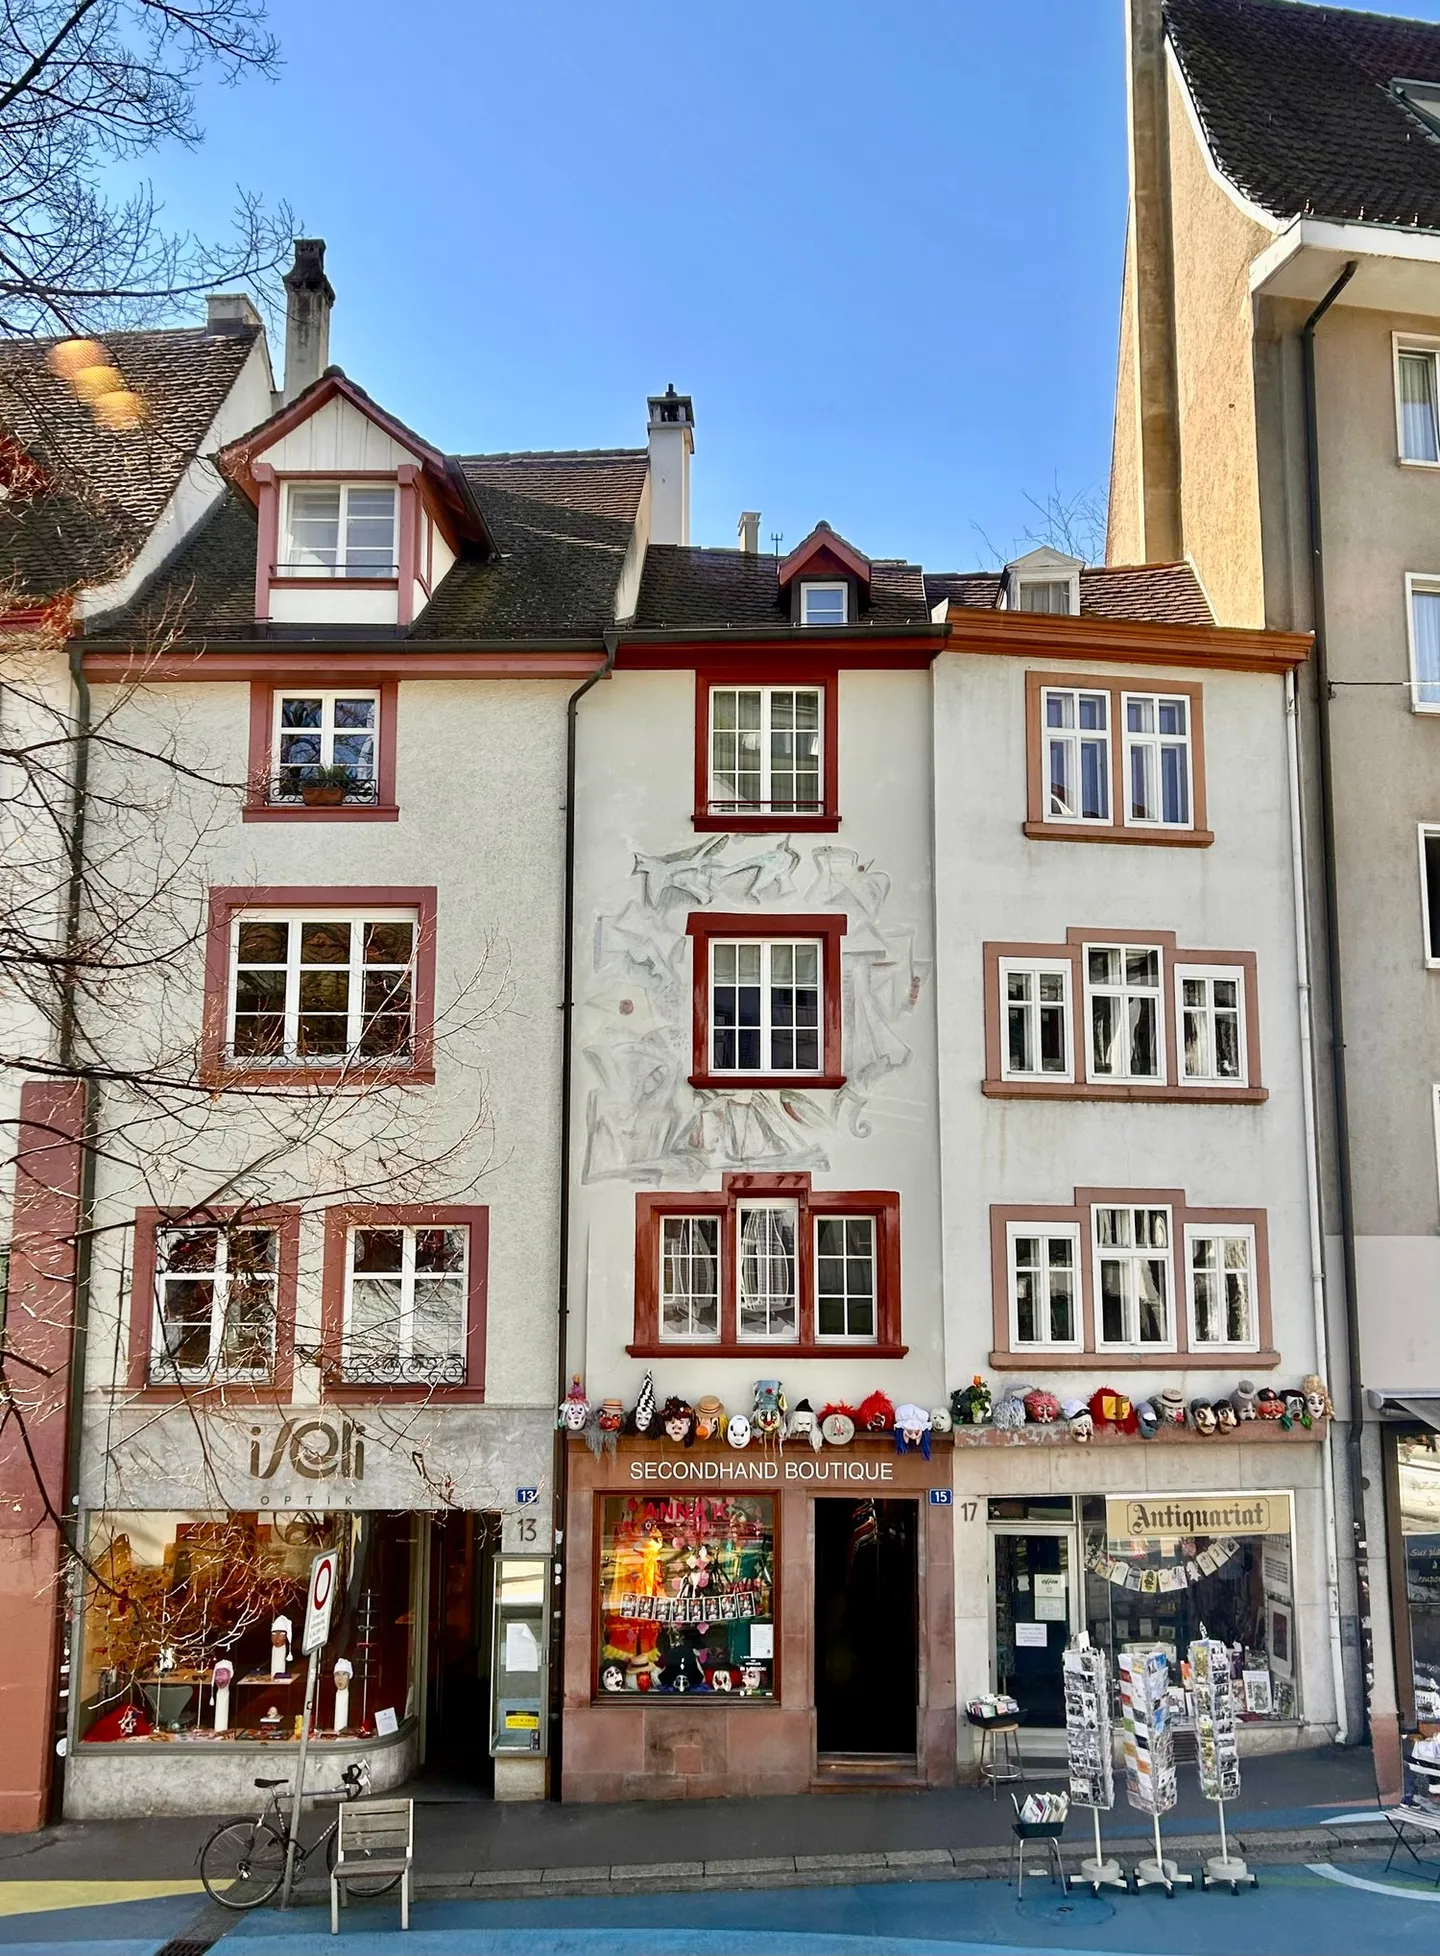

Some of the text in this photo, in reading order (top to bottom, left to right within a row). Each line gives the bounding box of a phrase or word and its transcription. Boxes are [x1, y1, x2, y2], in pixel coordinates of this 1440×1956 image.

[630, 1461, 894, 1481] SECONDHAND BOUTIQUE
[260, 1495, 353, 1506] OPTIK
[521, 1490, 535, 1502] 13
[935, 1491, 948, 1503] 15
[961, 1502, 978, 1522] 17
[1132, 1502, 1264, 1535] Antiquariat
[517, 1518, 537, 1541] 13
